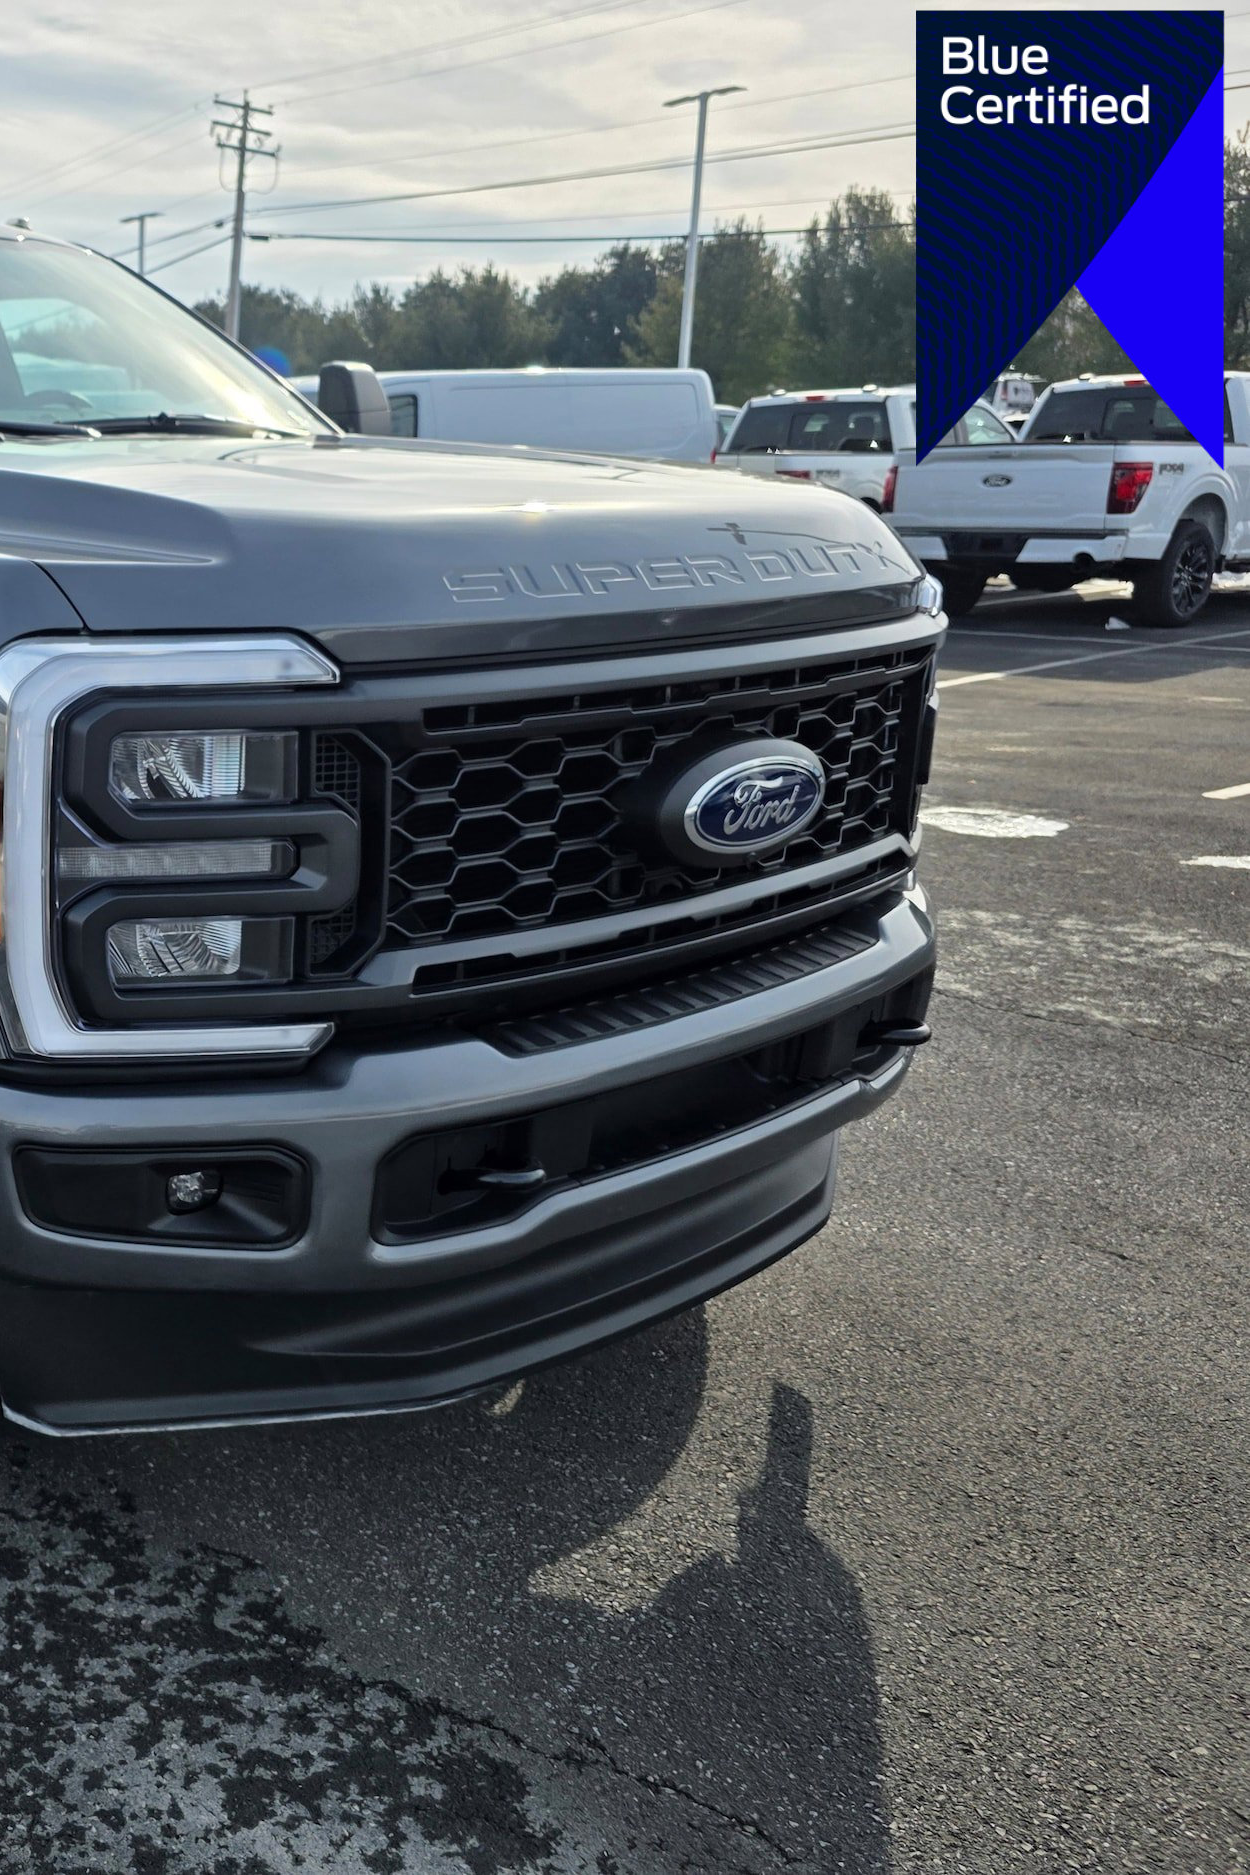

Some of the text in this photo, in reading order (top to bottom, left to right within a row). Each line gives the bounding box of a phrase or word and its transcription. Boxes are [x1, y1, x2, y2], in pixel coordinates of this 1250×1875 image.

[443, 541, 889, 602] SUPER DUTY
[723, 776, 800, 835] Ford
